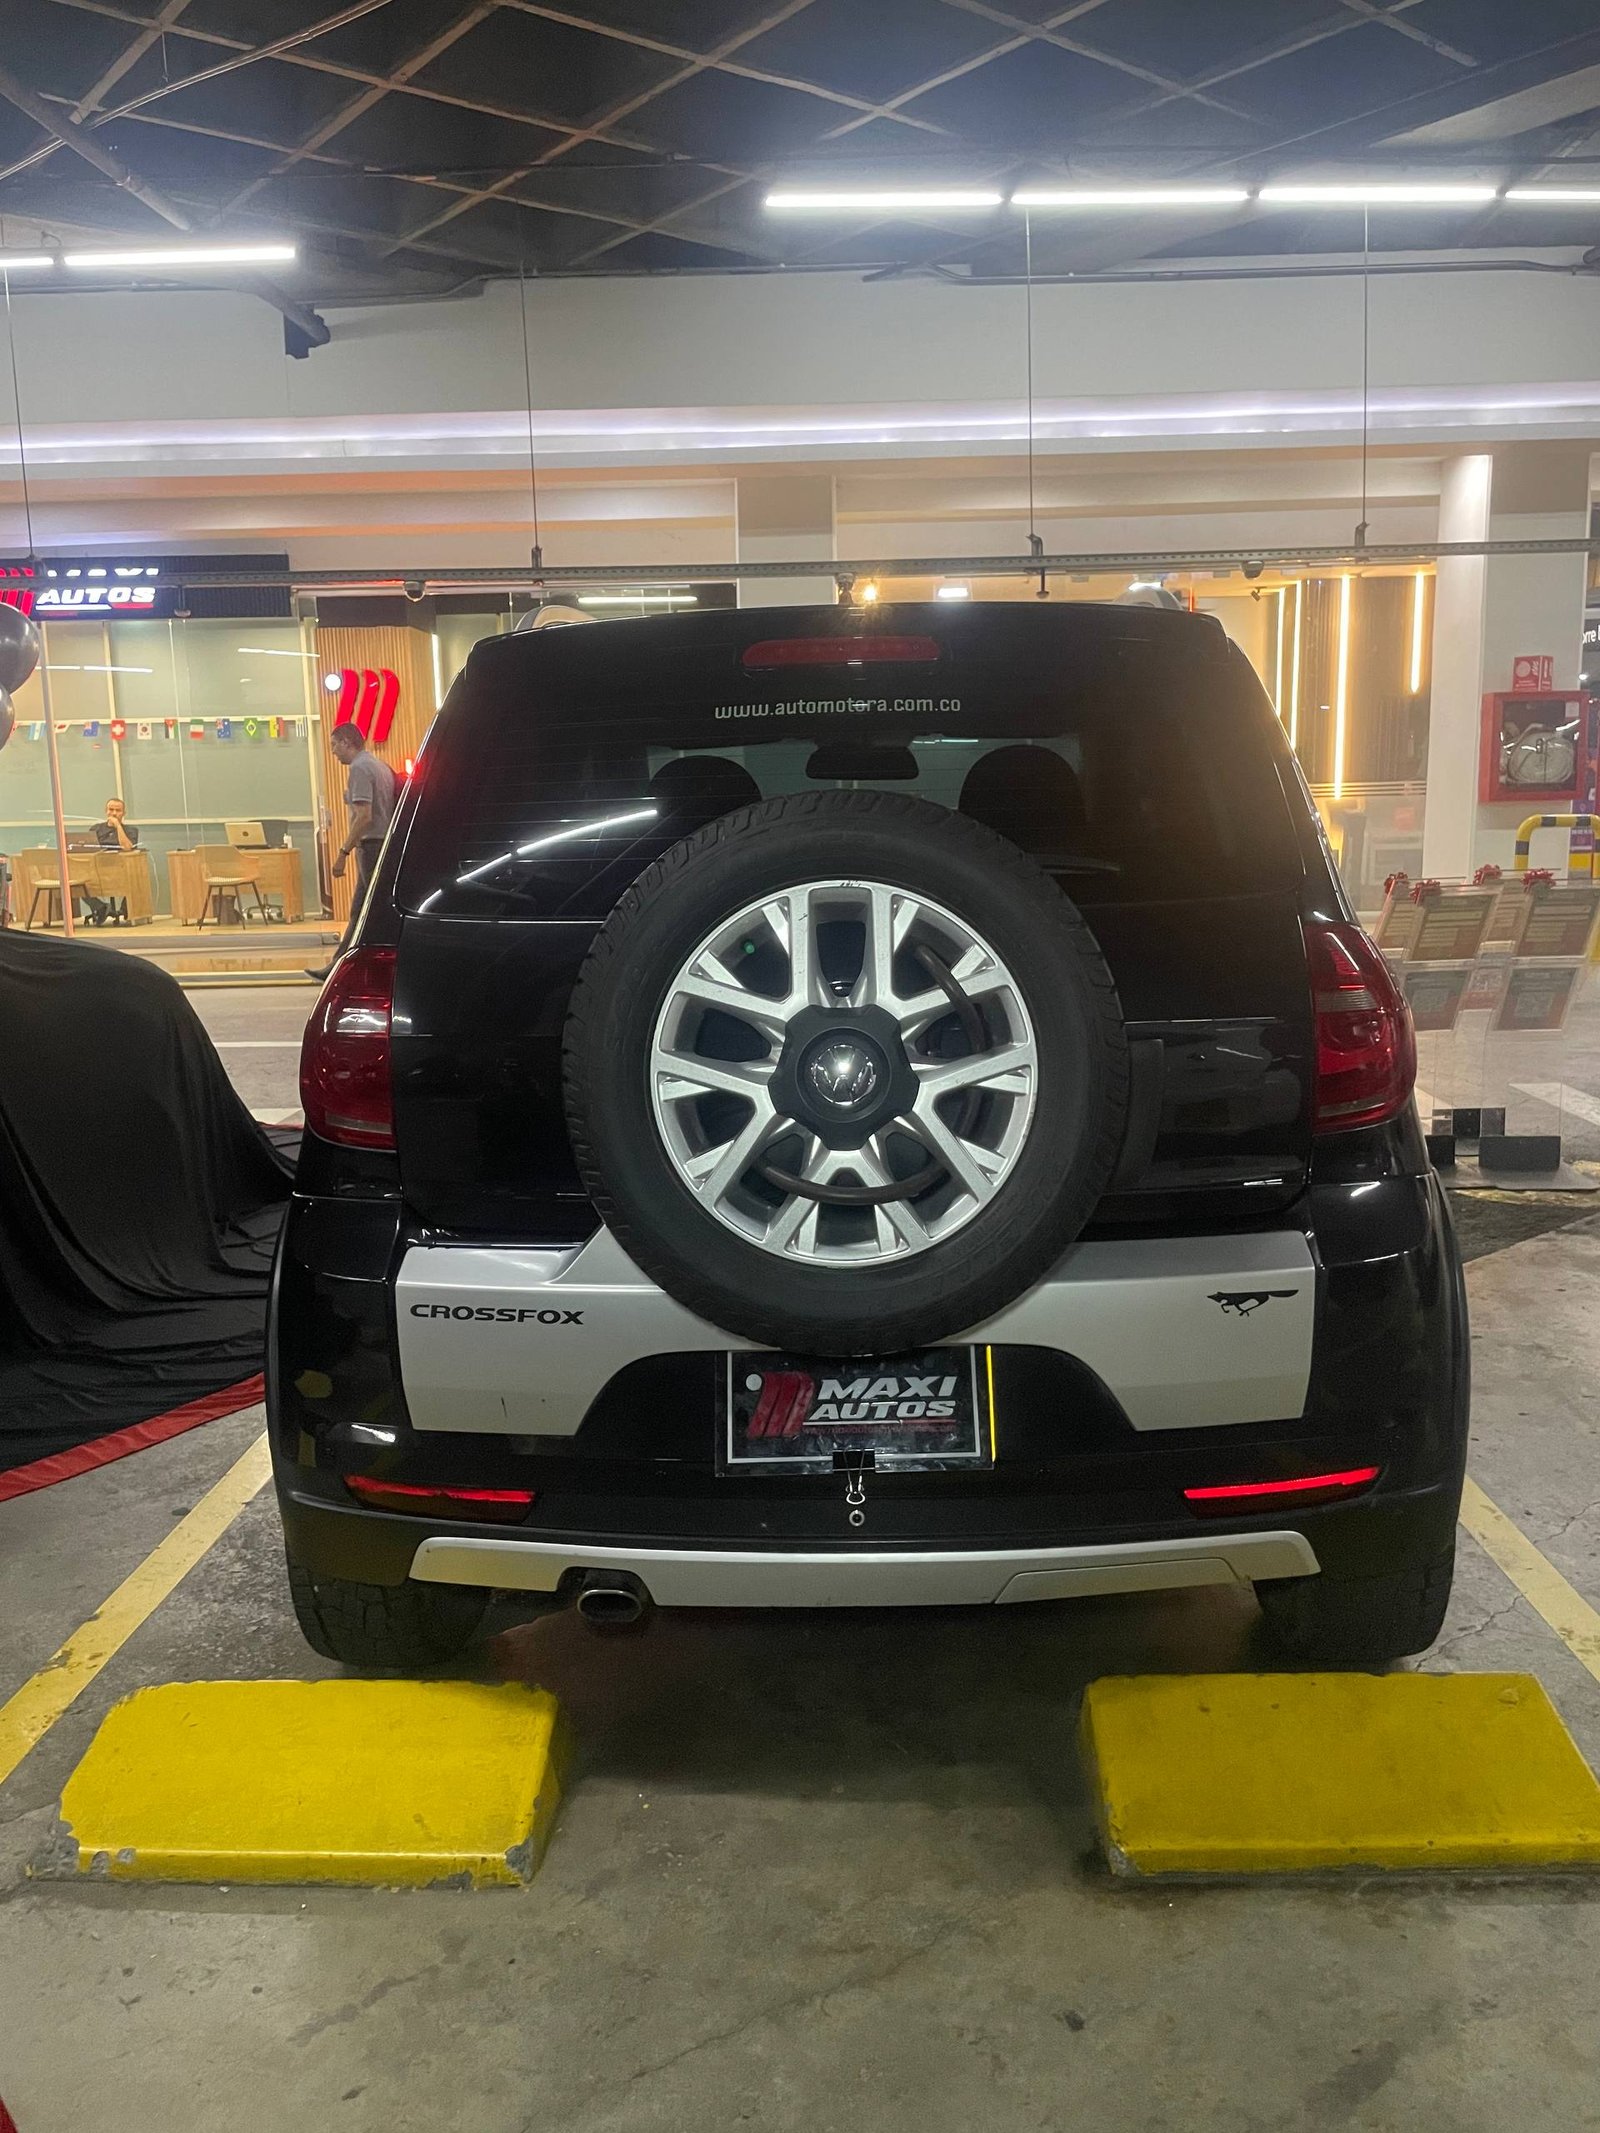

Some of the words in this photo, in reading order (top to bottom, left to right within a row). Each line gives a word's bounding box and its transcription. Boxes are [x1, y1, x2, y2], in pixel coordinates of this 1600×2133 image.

[36, 587, 156, 605] AUTOS
[714, 697, 962, 719] www.automotora.com.co
[409, 1303, 585, 1325] CROSSFOX
[817, 1375, 957, 1400] MAXI
[808, 1400, 956, 1421] AUTOS
